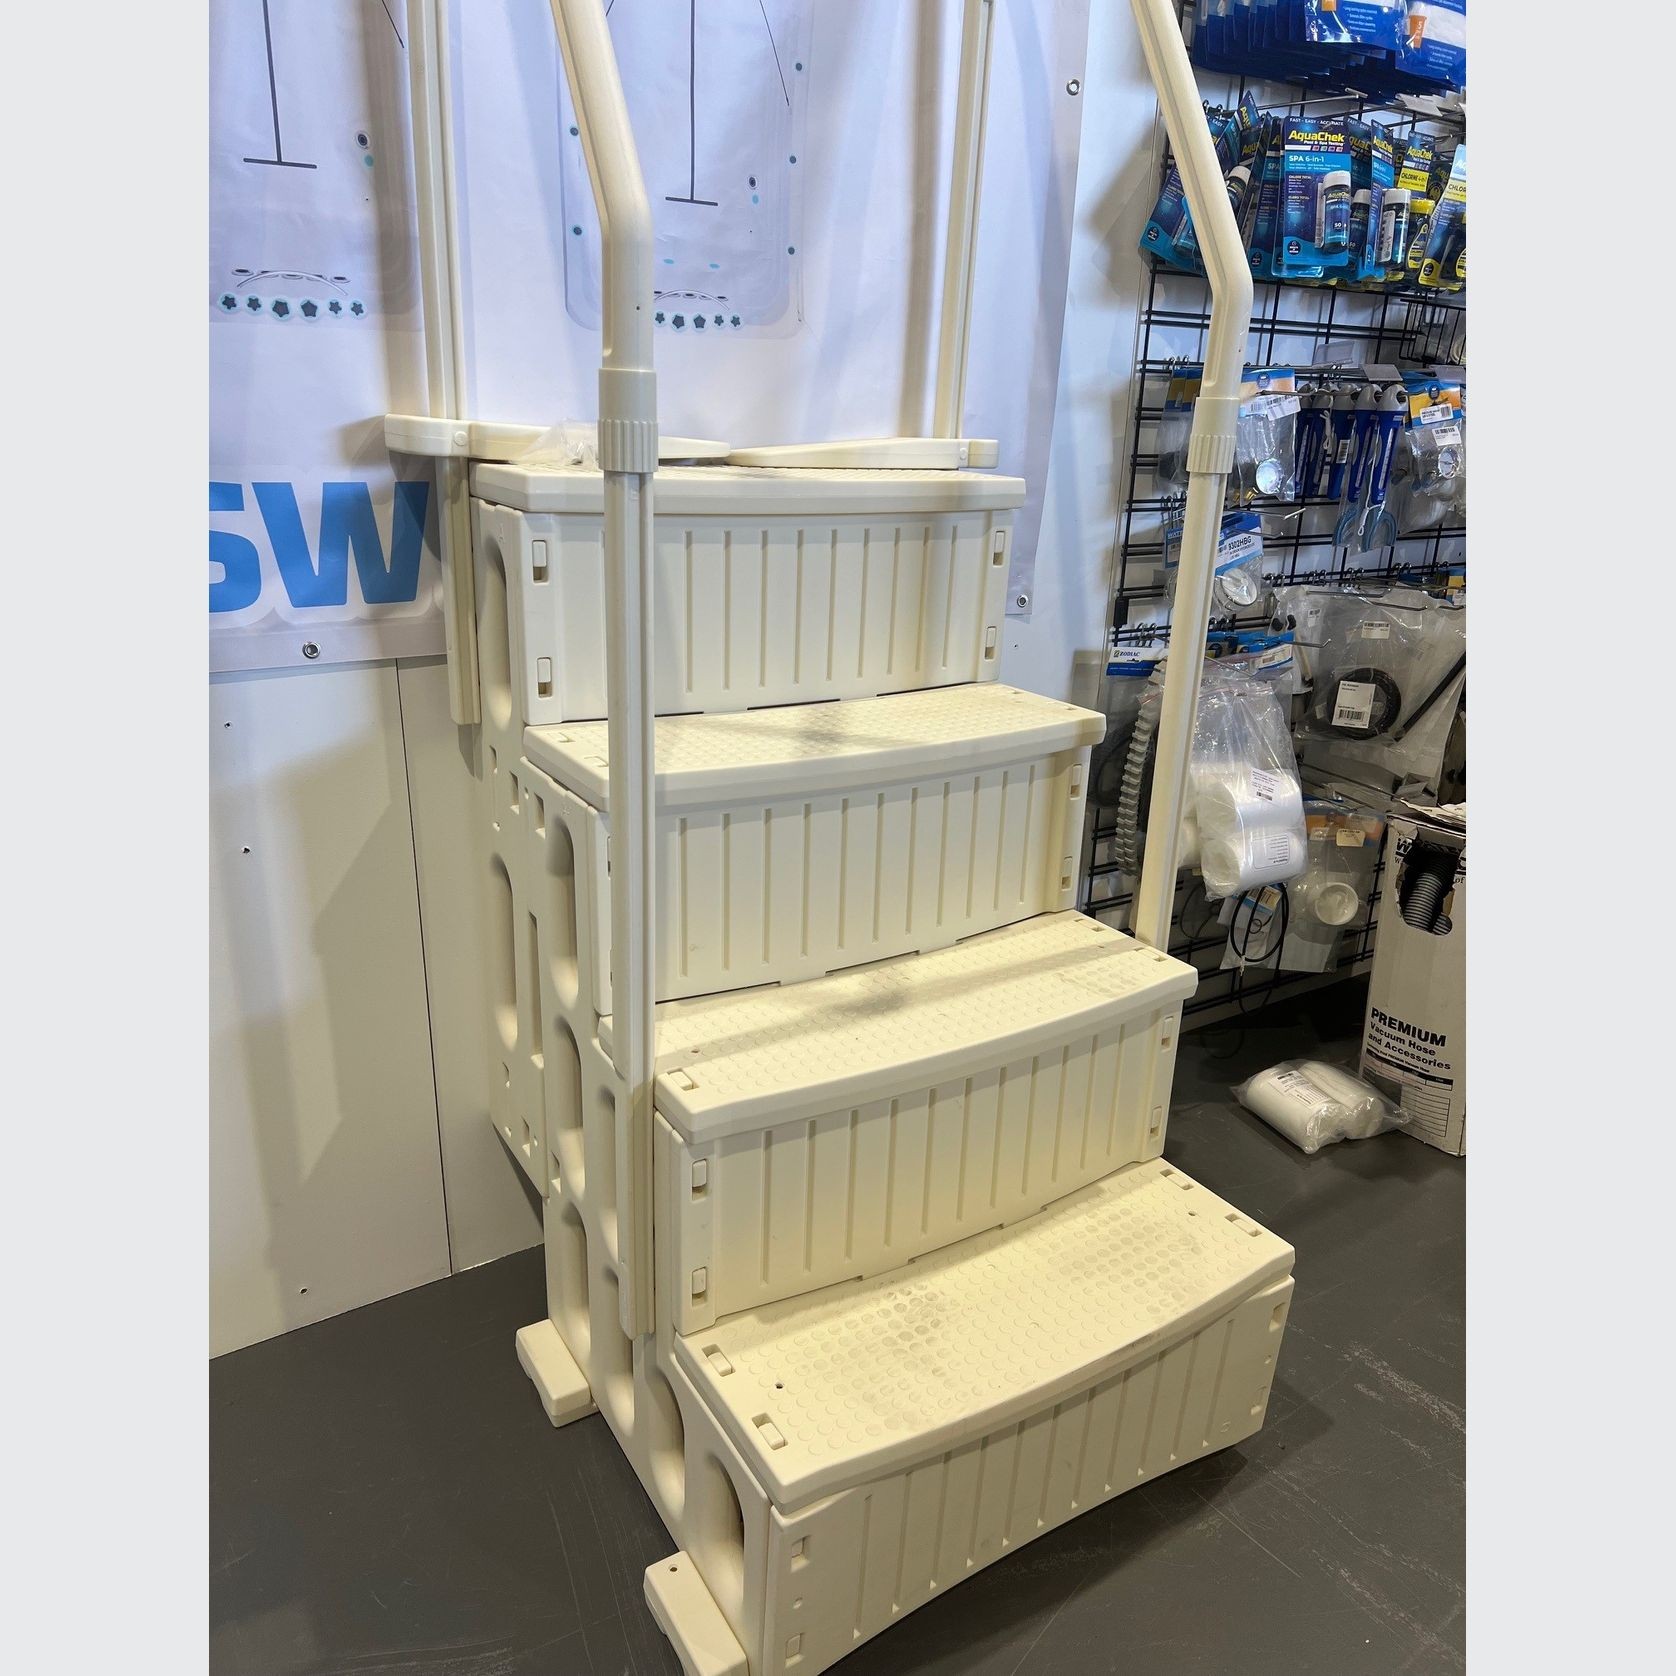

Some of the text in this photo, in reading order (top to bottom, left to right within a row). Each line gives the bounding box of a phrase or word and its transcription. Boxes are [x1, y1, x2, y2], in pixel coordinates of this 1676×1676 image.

[1288, 130, 1345, 143] AquaChek
[1370, 1006, 1447, 1048] PREMIUM
[1370, 1021, 1437, 1057] Vacuum Hose
[1368, 1032, 1382, 1046] and
[1384, 1041, 1452, 1071] Accessories
